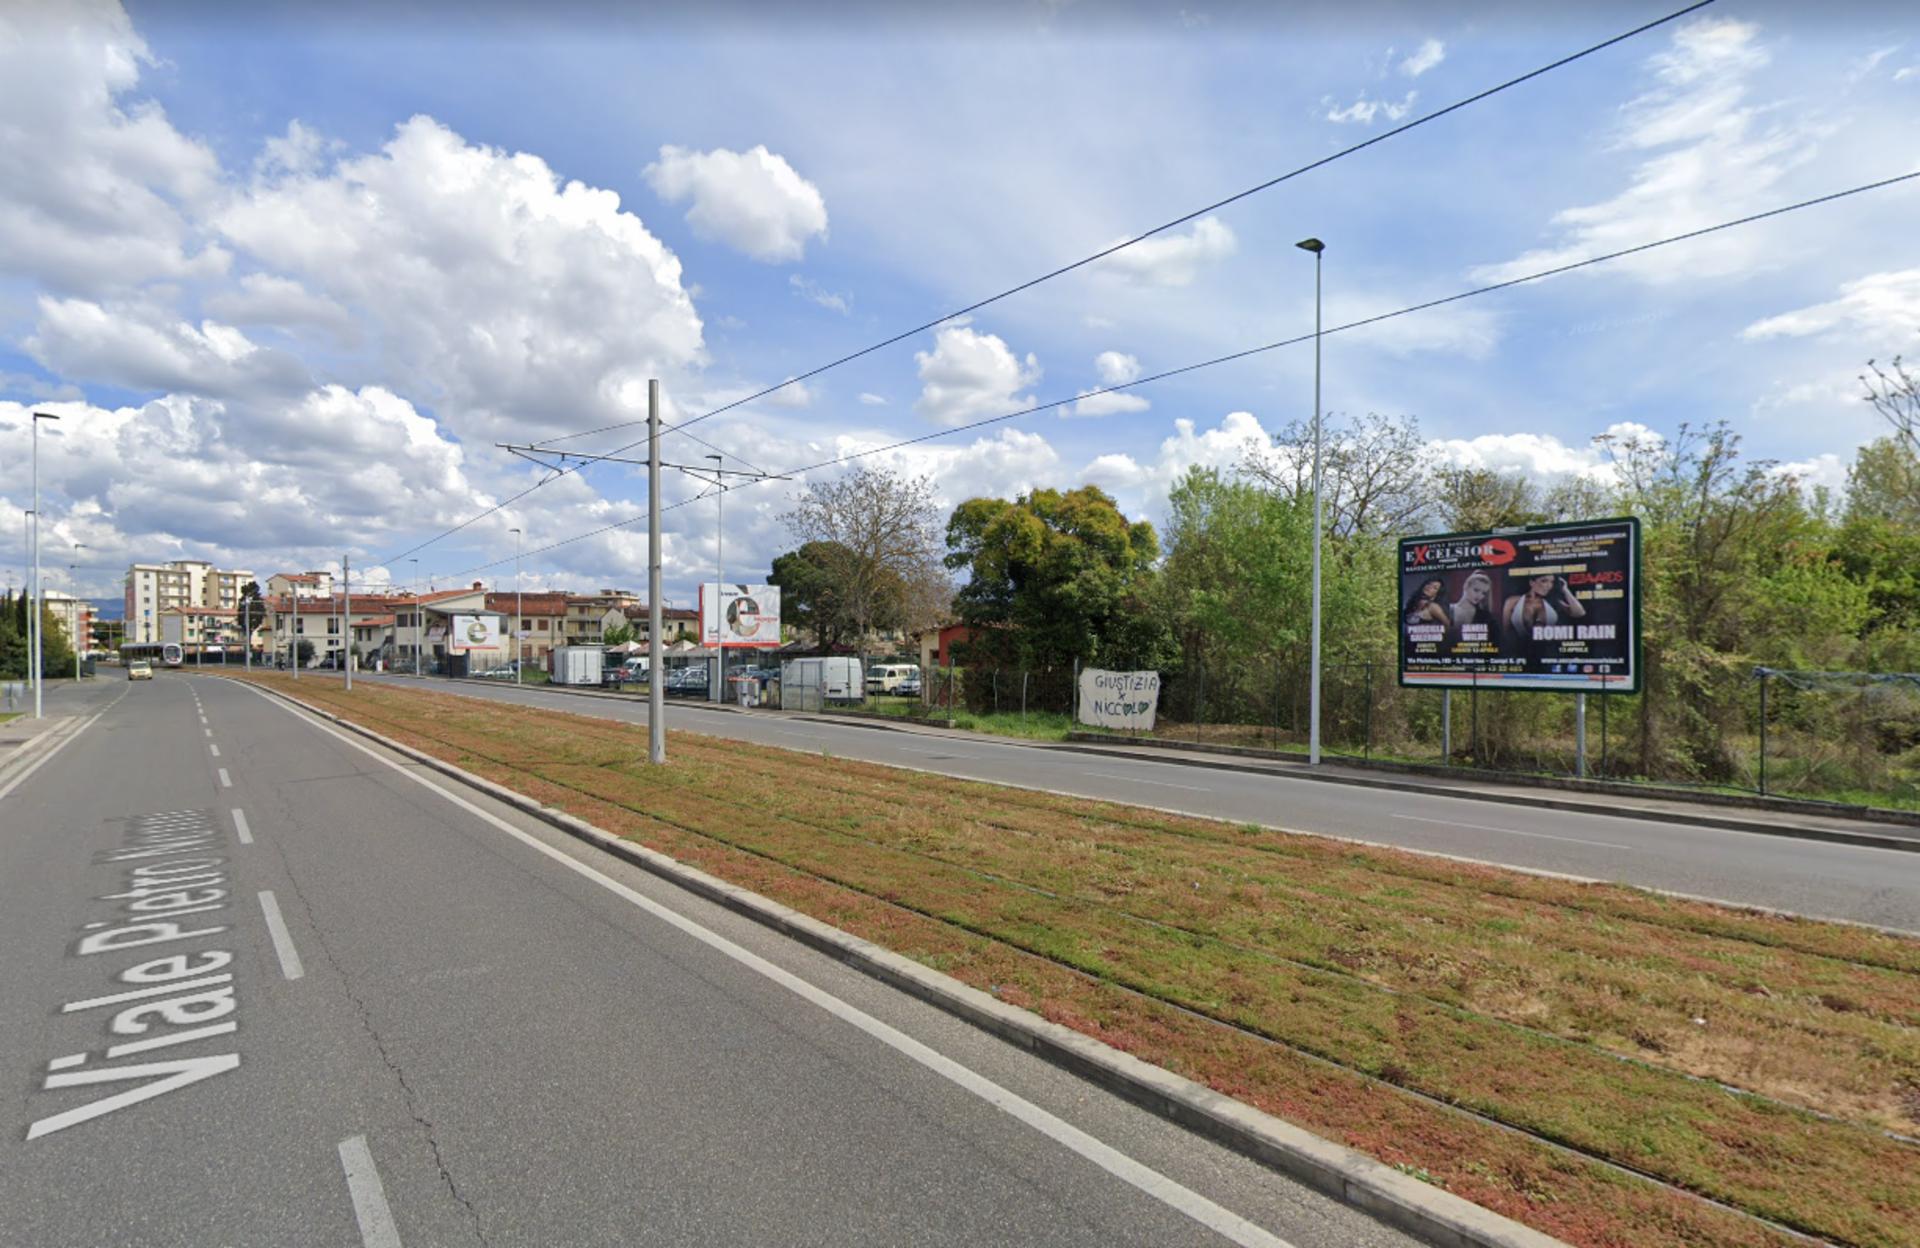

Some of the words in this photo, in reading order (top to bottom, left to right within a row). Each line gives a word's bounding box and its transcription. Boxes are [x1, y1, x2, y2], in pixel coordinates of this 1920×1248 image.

[1405, 544, 1494, 566] EXCELSIOR
[1533, 625, 1574, 640] ROMI
[1577, 624, 1616, 639] RAIN
[1095, 673, 1157, 690] GIUSTIZIA
